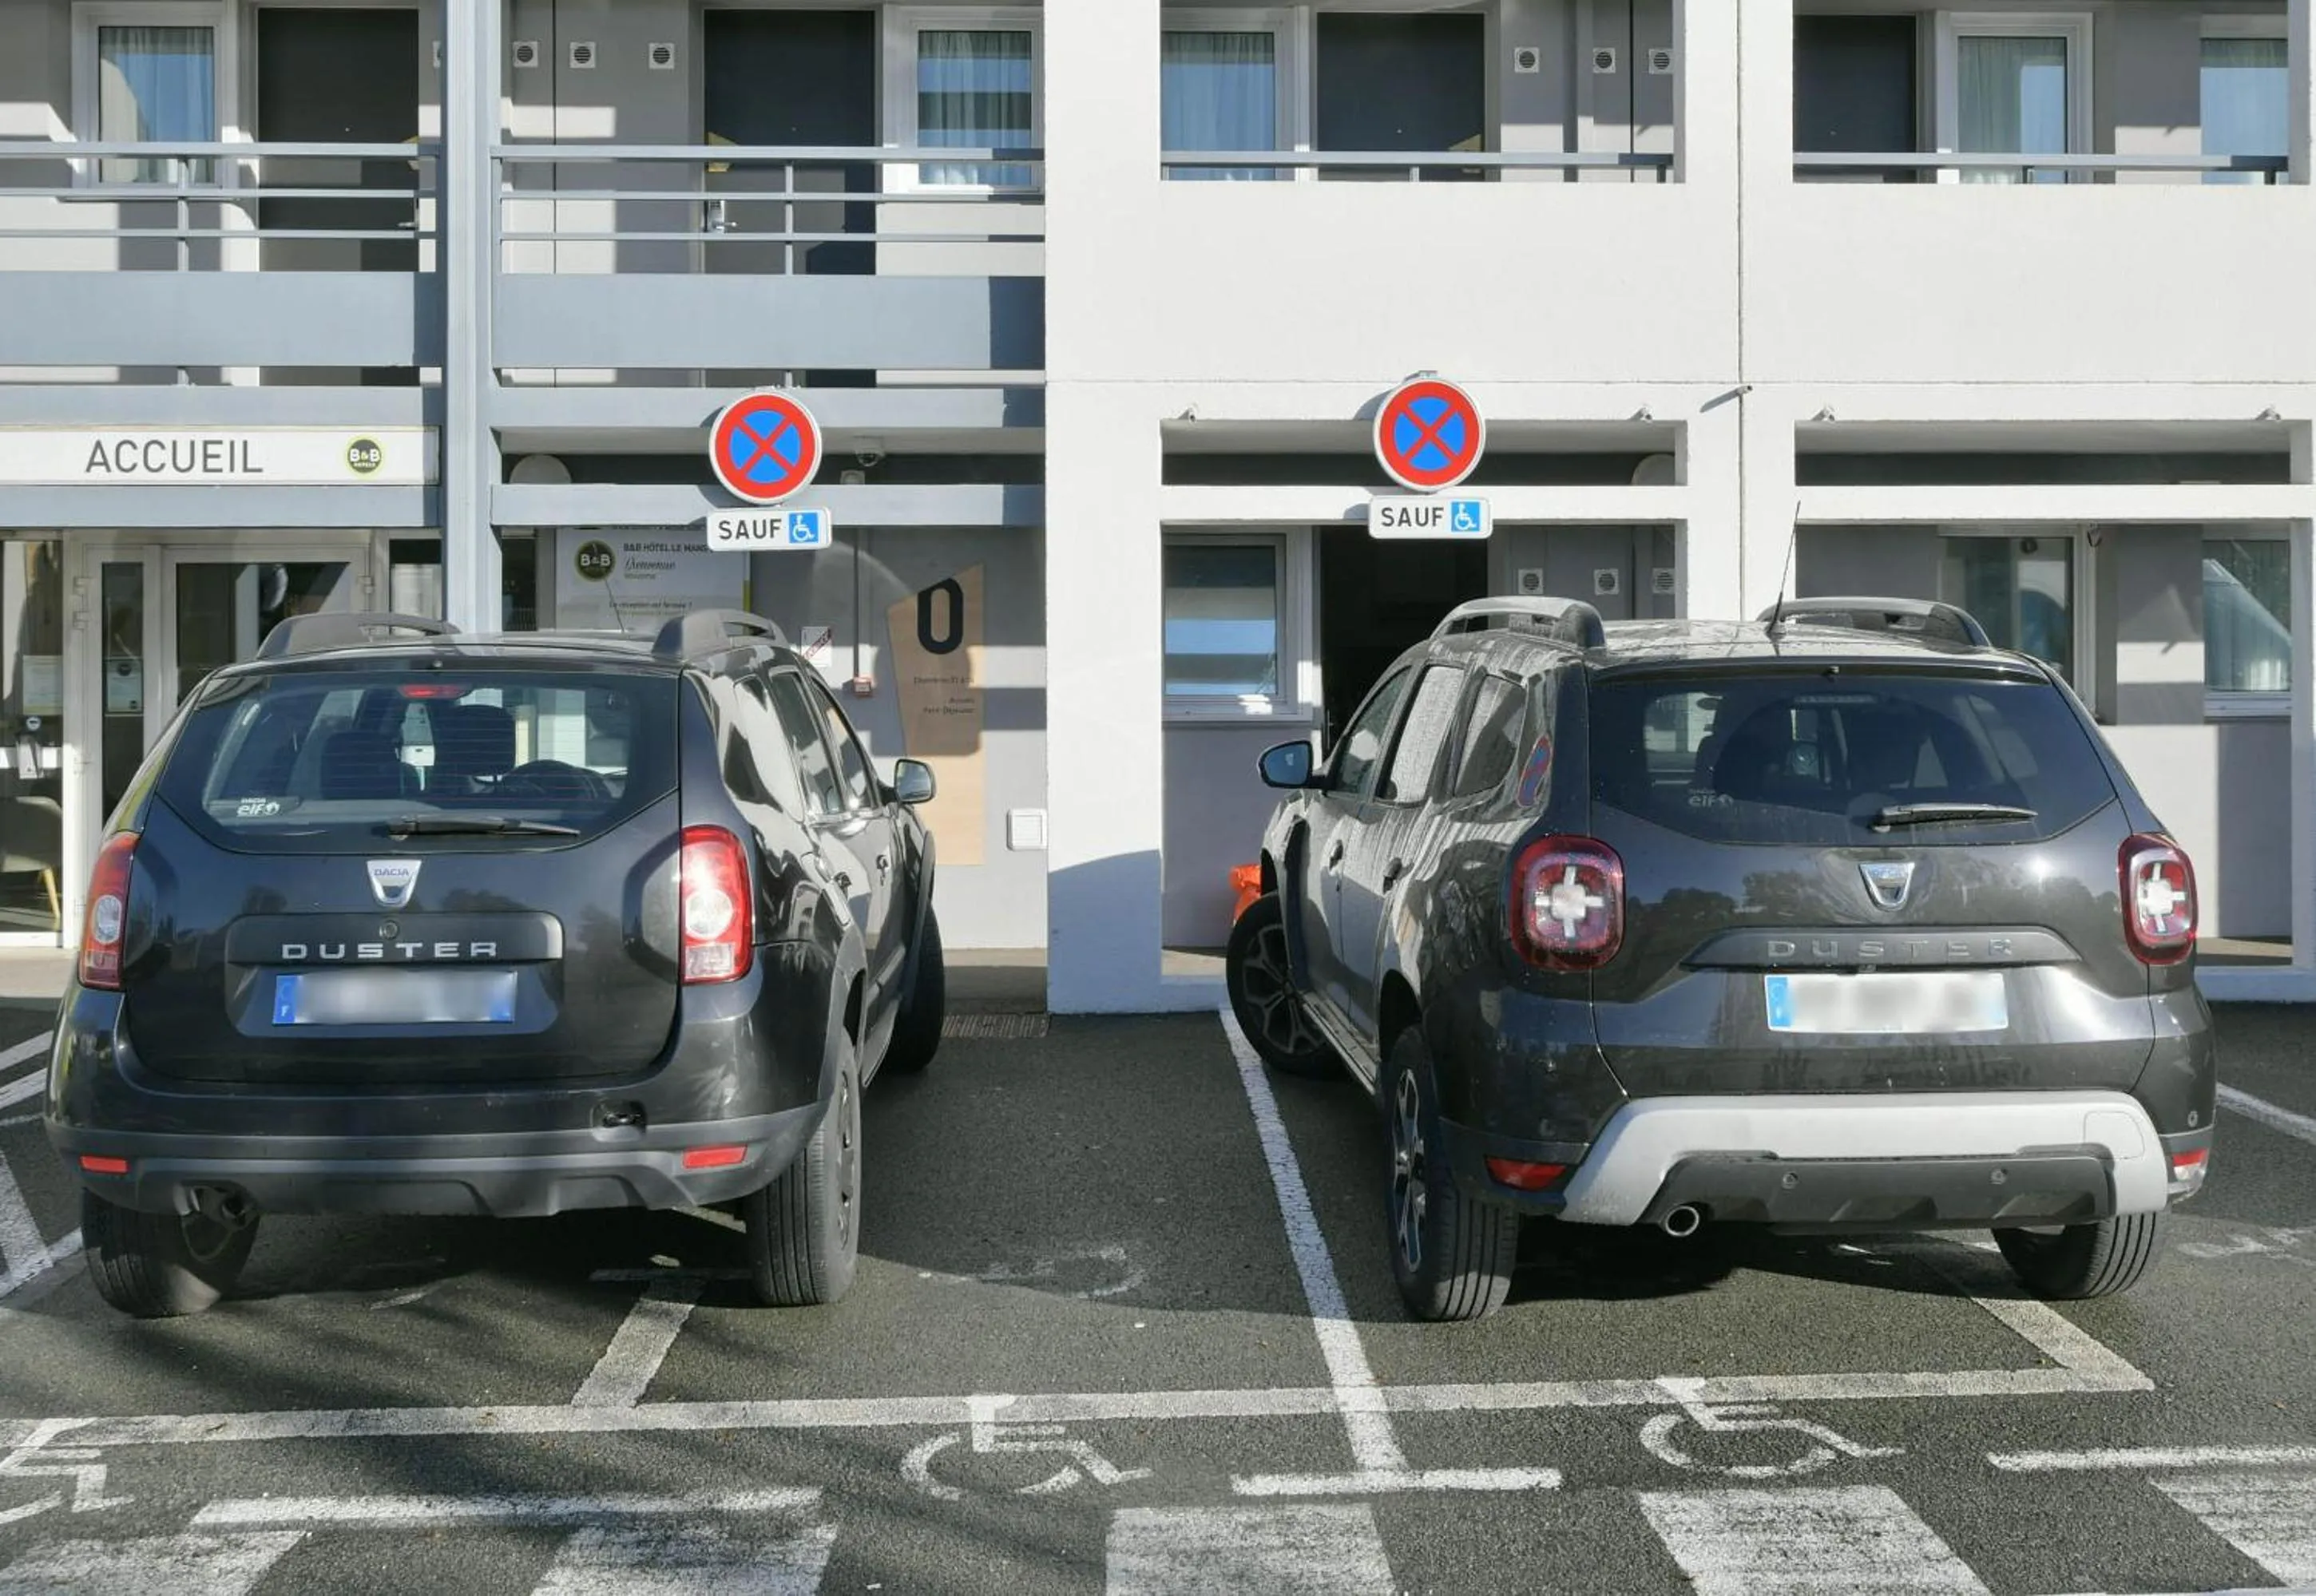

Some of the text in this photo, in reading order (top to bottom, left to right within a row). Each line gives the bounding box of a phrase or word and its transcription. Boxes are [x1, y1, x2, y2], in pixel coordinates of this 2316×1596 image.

[85, 439, 264, 473] ACCUEIL
[350, 448, 380, 462] B&B
[1382, 507, 1444, 527] SAUF
[719, 519, 782, 540] SAUF
[581, 553, 611, 566] B&B
[282, 942, 497, 959] DUSTER
[1767, 938, 2012, 958] DUSTER
